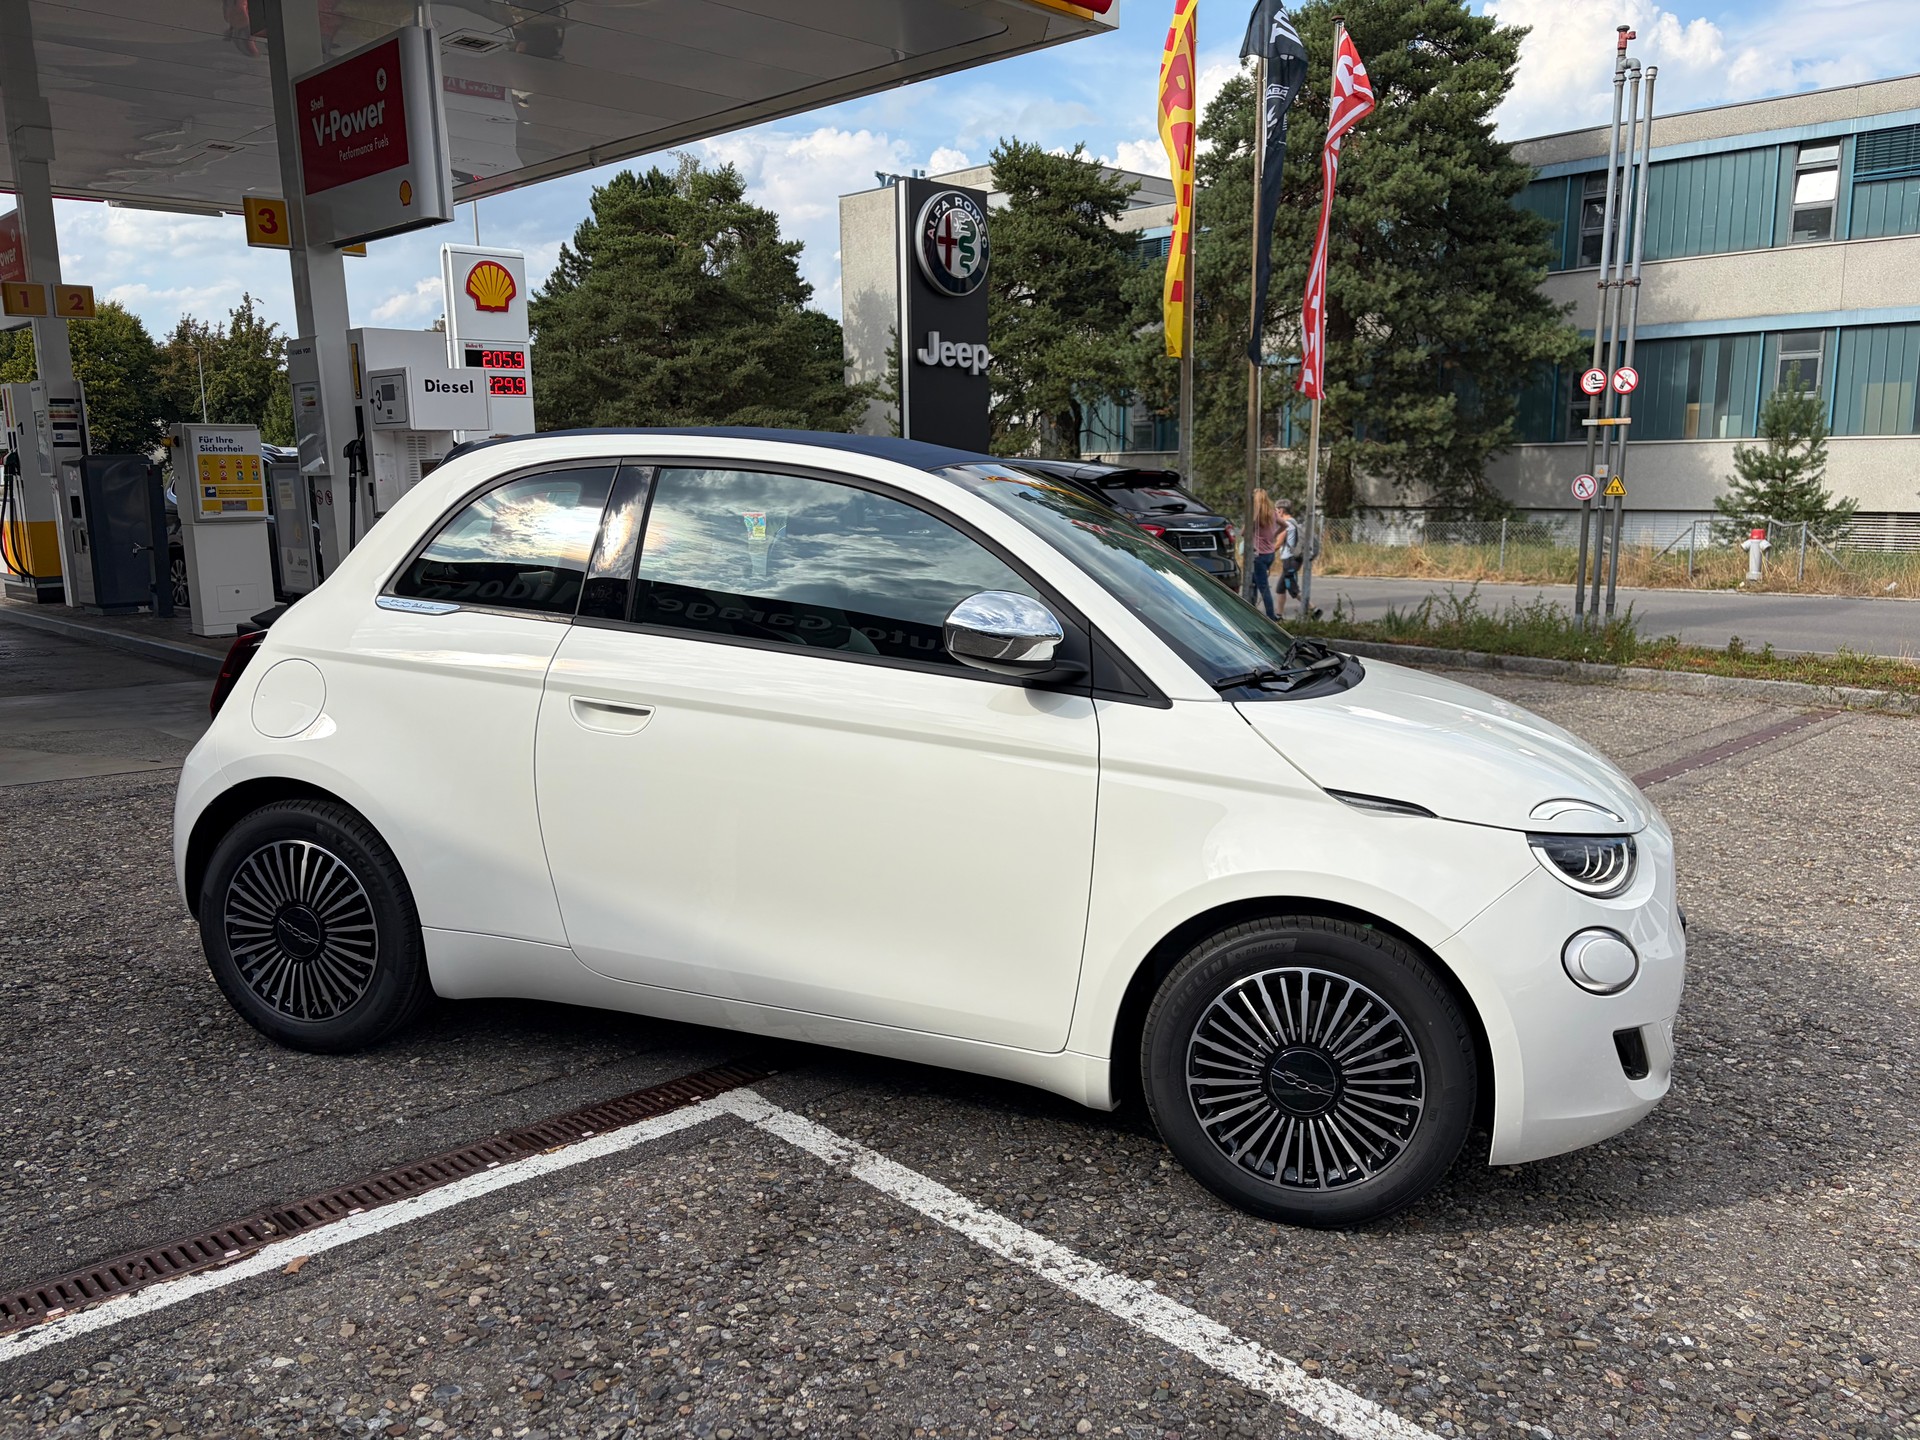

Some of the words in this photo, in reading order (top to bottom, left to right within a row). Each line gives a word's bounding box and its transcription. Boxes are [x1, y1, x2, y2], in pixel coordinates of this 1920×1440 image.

[310, 96, 324, 111] Shell
[311, 99, 386, 147] V-Power
[338, 142, 374, 162] Performance
[374, 134, 389, 150] Fuels
[258, 208, 278, 234] 3
[926, 200, 951, 241] ALFA
[954, 196, 988, 249] ROMEO
[0, 247, 16, 267] ower
[19, 291, 29, 307] 1
[69, 294, 84, 311] 2
[482, 350, 524, 369] 205.9
[917, 331, 989, 376] Jeep
[424, 379, 473, 393] Diesel
[375, 389, 382, 411] 3
[17, 422, 24, 435] 1
[200, 444, 243, 452] Sicherheit
